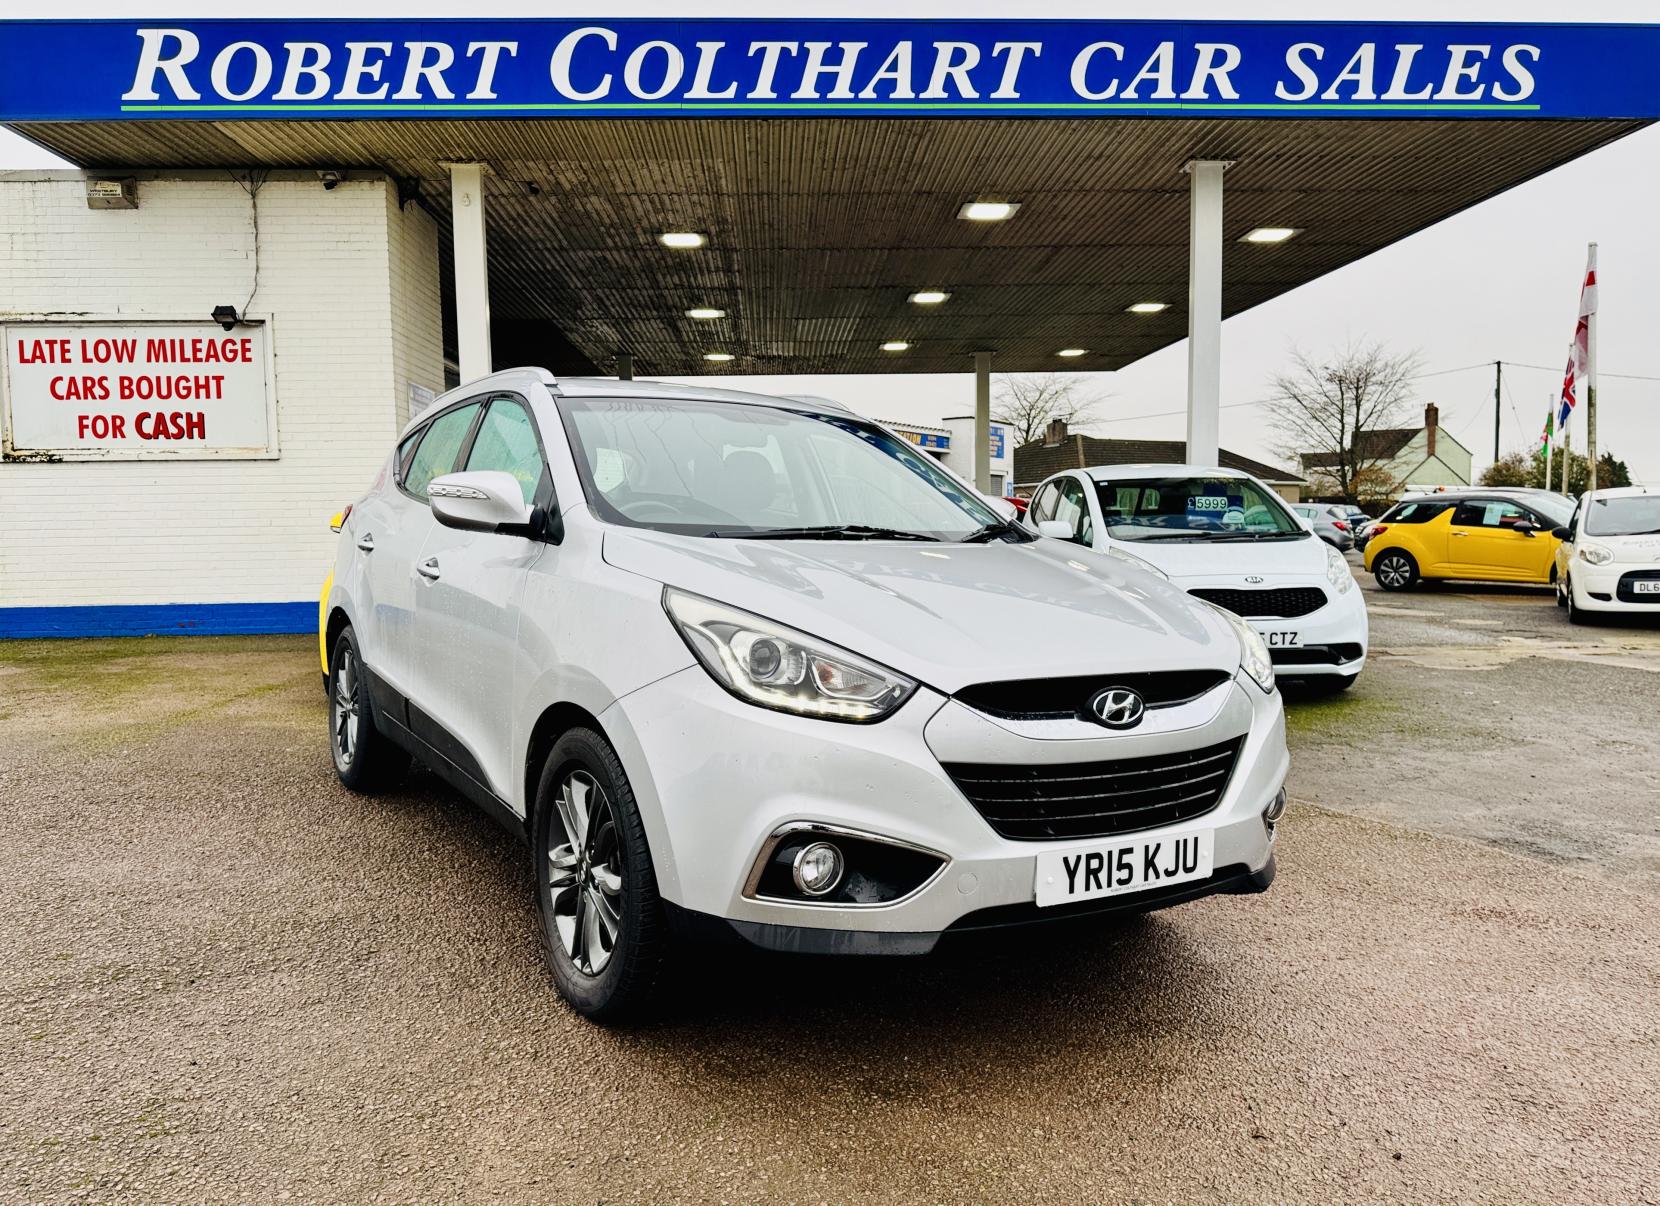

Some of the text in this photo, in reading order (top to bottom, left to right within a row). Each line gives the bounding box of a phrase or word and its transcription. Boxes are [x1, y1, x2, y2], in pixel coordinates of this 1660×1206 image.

[121, 27, 1541, 101] ROBERT COLTHART CAR SALES
[18, 338, 253, 364] LATE LOW MILEAGE
[50, 374, 225, 400] CARS BOUGHT
[78, 411, 206, 440] FOR CASH
[1269, 631, 1298, 646] CTZ
[1062, 836, 1199, 894] YR15 KJU
